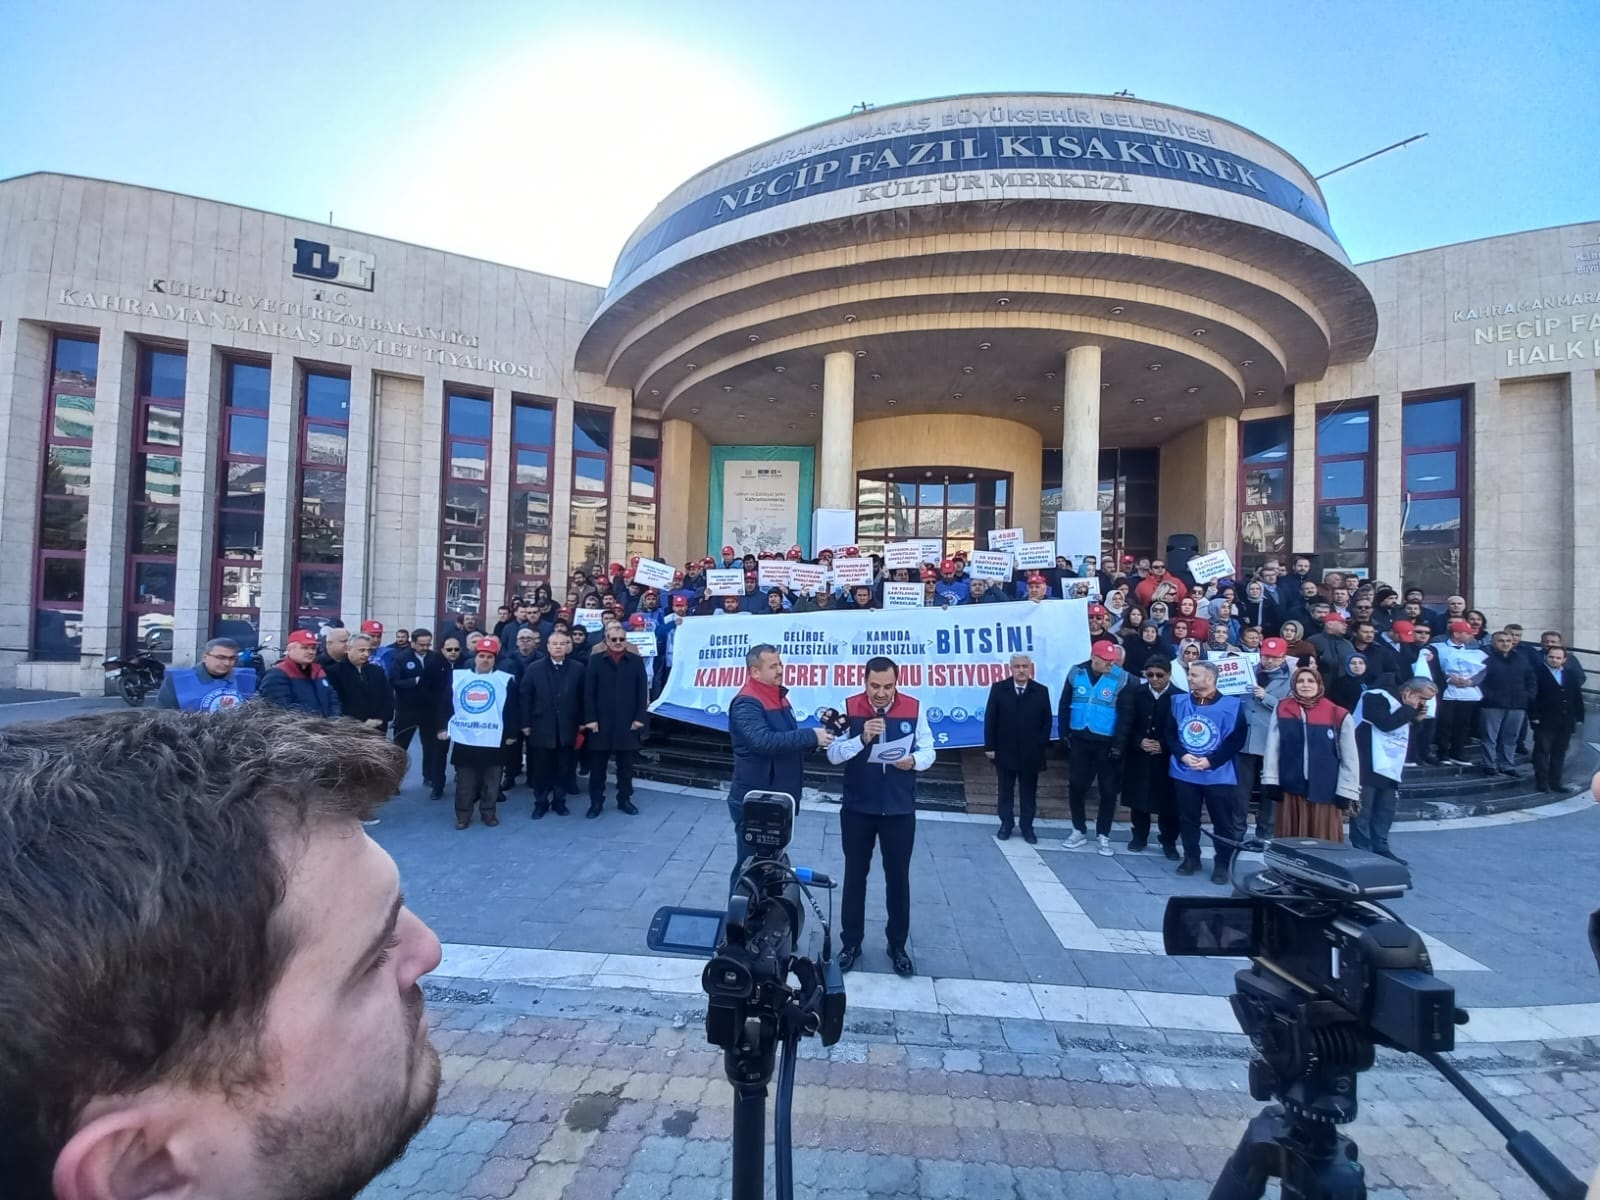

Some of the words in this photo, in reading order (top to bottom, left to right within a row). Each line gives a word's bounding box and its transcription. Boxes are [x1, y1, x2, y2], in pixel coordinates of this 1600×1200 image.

[745, 117, 932, 176] KAHRAMANMARAŞ
[941, 106, 1090, 127] BÜYÜKŞEHİR
[1100, 111, 1216, 145] BELEDİYESİ
[713, 159, 840, 217] NECİP
[845, 137, 988, 180] FAZIL
[998, 136, 1267, 194] KISAKÜREK
[857, 173, 984, 203] KÜLTÜR
[990, 173, 1132, 193] MERKEZİ
[248, 295, 276, 313] VE
[58, 288, 322, 346] KAHRAMANMARAŞ
[327, 331, 417, 359] DEVLET
[423, 346, 543, 380] TİYATROSU
[1474, 315, 1560, 345] NECİP
[1506, 340, 1585, 367] HALK
[709, 634, 749, 647] ÜCRETTE
[783, 629, 825, 642] GELİRDE
[866, 630, 911, 642] KAMUDA
[936, 623, 1034, 654] BİTSİN!
[699, 646, 752, 660] DENGESİZL
[776, 642, 839, 656] DALETSİZLİK
[851, 643, 926, 656] HUZURSUZLUK
[694, 665, 746, 687] KAMU
[784, 664, 829, 687] CRET
[832, 663, 922, 687] REFMU
